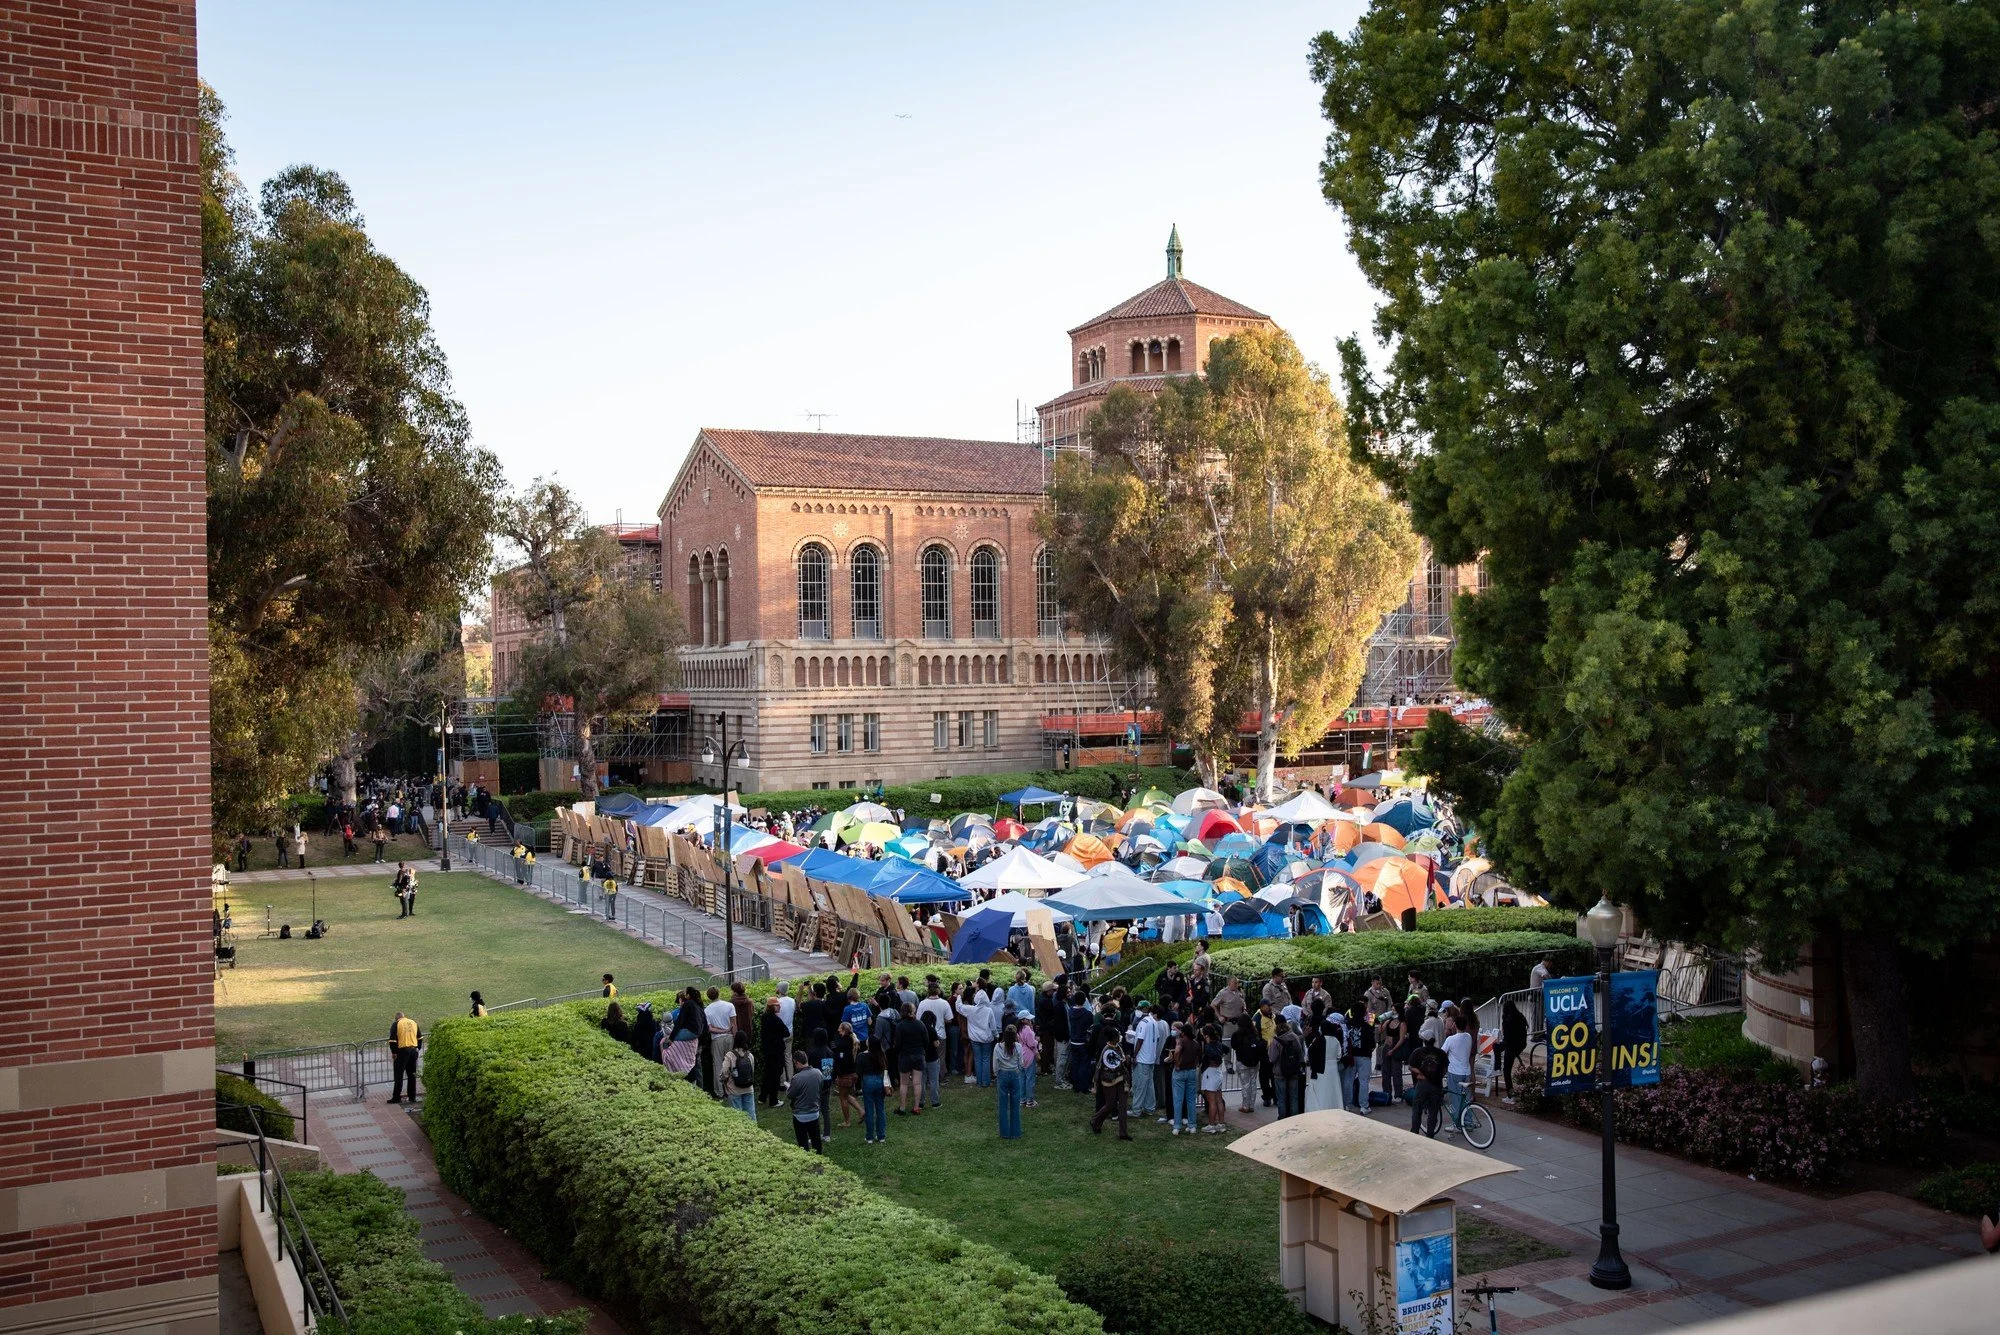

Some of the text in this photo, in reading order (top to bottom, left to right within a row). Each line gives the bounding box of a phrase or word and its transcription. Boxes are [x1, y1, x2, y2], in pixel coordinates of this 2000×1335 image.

[1550, 993, 1588, 1013] UCLA
[1551, 1021, 1589, 1050] GO
[1551, 1042, 1658, 1078] BRU INS!
[1402, 1298, 1448, 1315] BRUINS CAN
[1402, 1314, 1418, 1324] GET
[1403, 1320, 1429, 1332] BONUS
